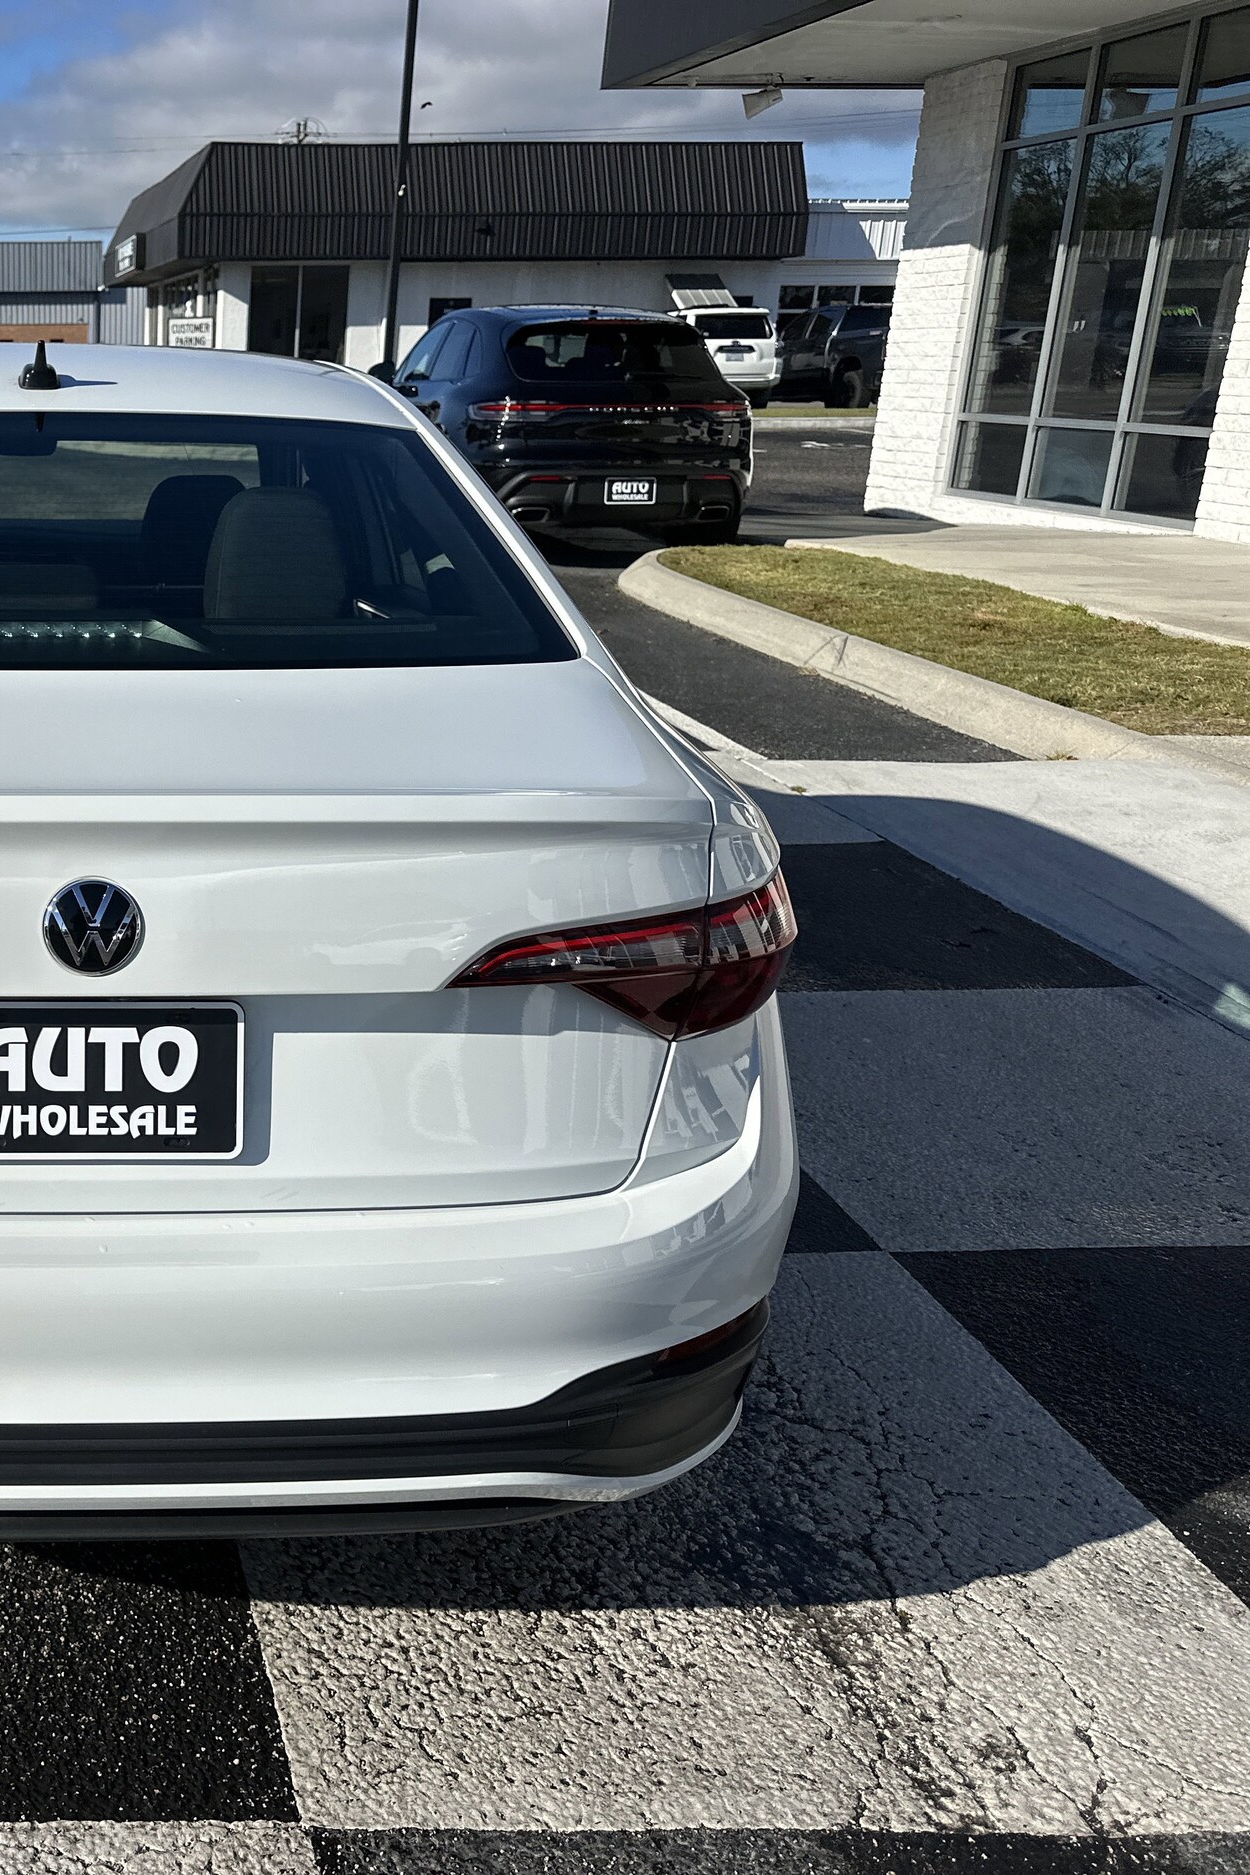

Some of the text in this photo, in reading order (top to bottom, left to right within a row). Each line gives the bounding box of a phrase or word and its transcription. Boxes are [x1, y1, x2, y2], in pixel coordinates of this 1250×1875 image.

[171, 323, 210, 334] CUSTOMER
[175, 336, 207, 346] PARKING
[612, 481, 649, 494] AUTO
[612, 493, 649, 501] WHOLESALE
